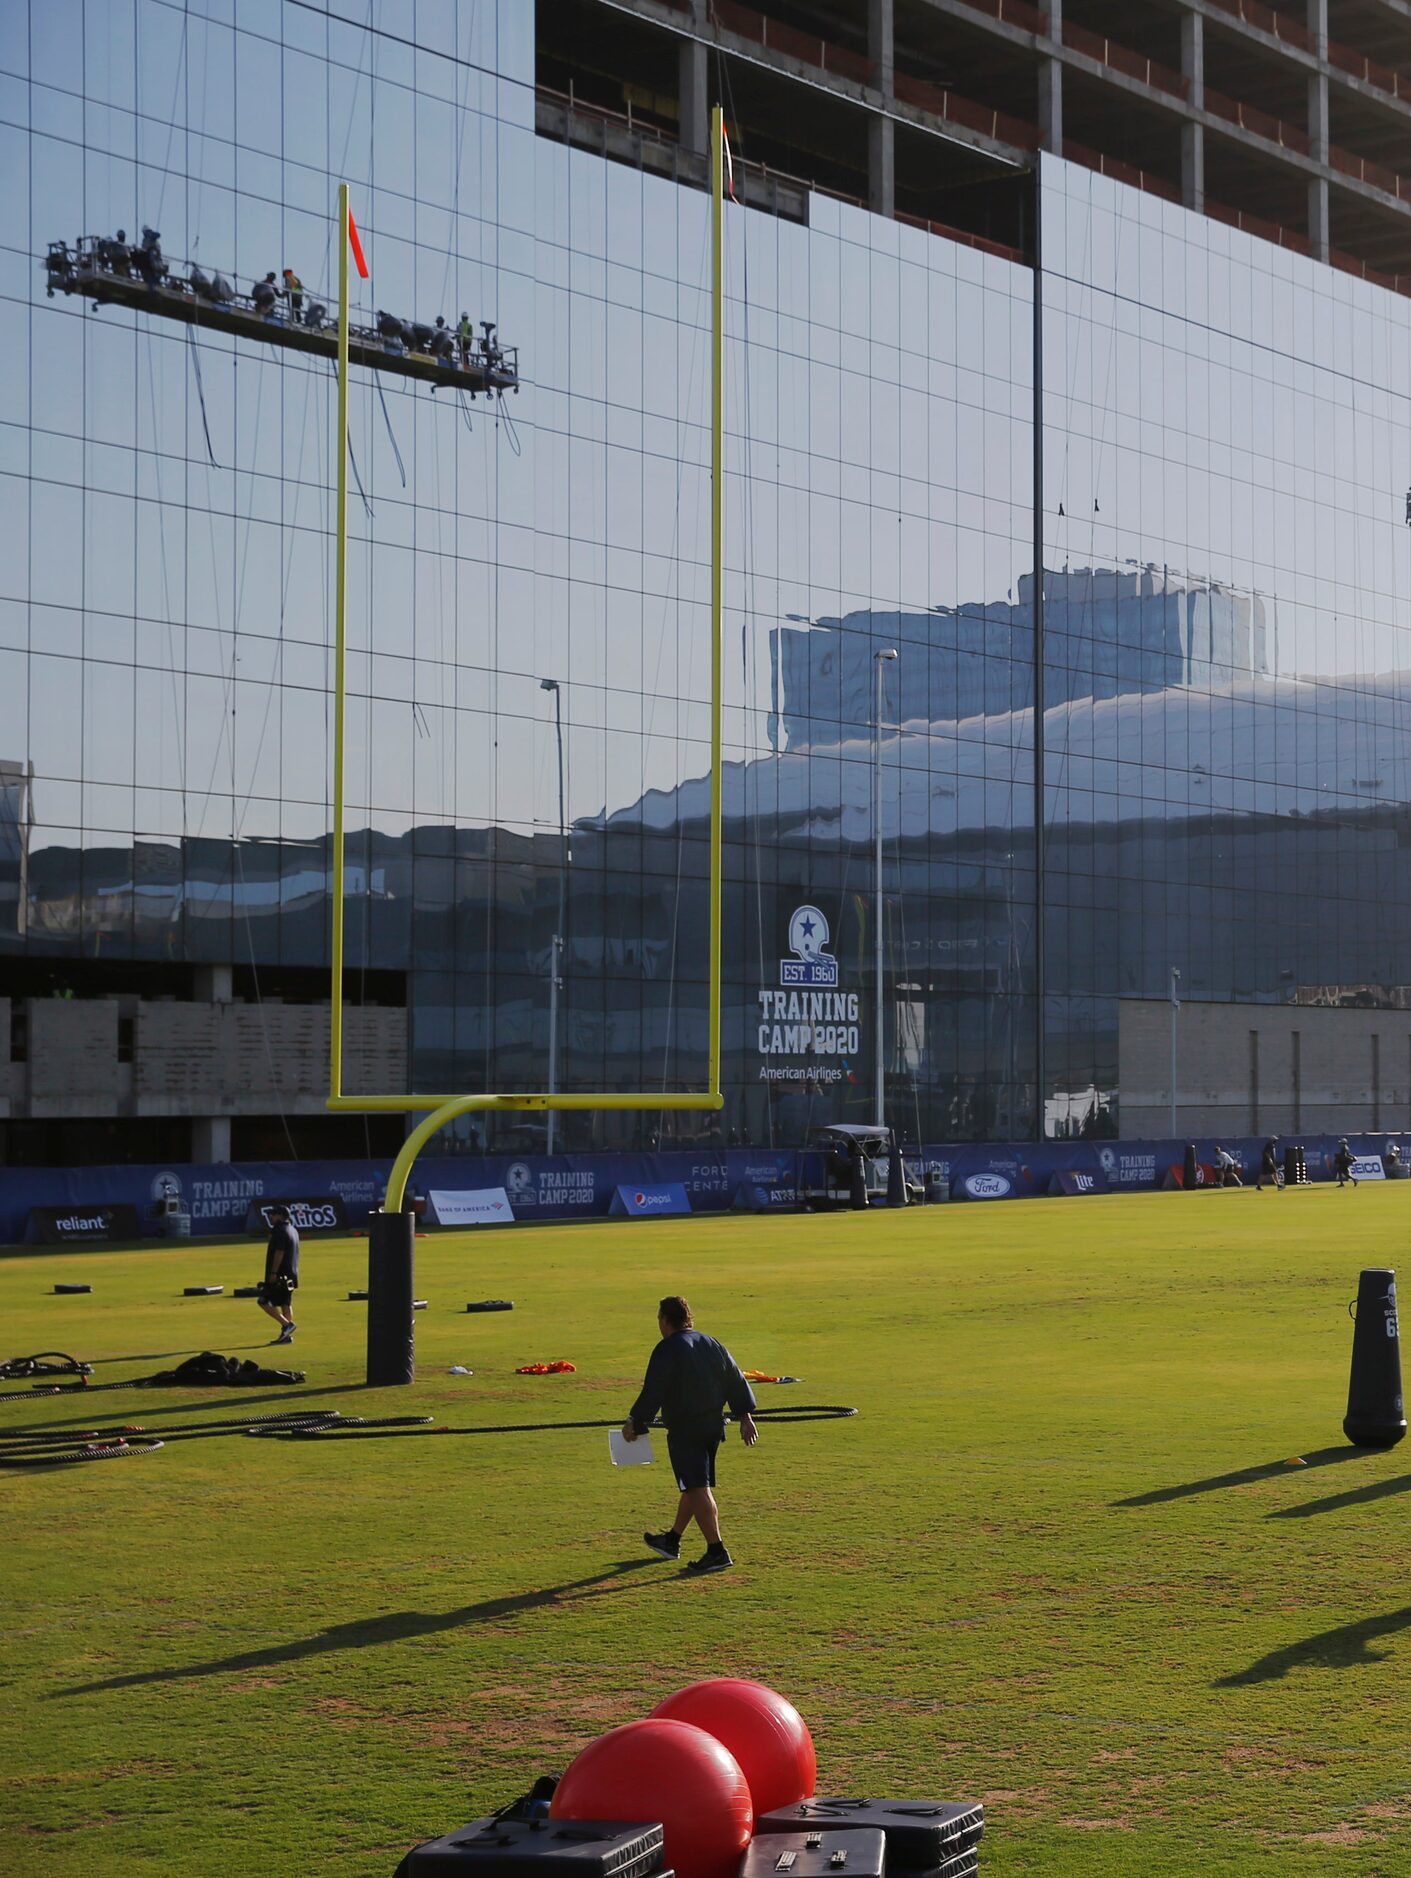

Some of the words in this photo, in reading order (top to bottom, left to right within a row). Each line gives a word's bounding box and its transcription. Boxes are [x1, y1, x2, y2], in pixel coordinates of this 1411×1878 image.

[783, 964, 808, 981] EST.
[811, 965, 835, 982] 1960
[758, 990, 859, 1022] TRAINING
[758, 1024, 812, 1054] CAMP
[815, 1025, 859, 1055] 2020
[759, 1065, 806, 1080] American
[807, 1066, 842, 1081] Airlines
[1119, 1154, 1156, 1169] TRAINING
[329, 1180, 375, 1192] American
[539, 1172, 595, 1188] TRAINING
[684, 1180, 728, 1192] CENTE
[975, 1177, 1001, 1193] Ford
[1074, 1174, 1094, 1191] Lite
[192, 1179, 264, 1200] TRAINING
[539, 1188, 568, 1205] CAMP
[568, 1188, 594, 1204] 2020
[647, 1189, 672, 1206] pepsi
[191, 1199, 231, 1218] CAMP
[232, 1199, 251, 1216] 20
[463, 1205, 490, 1213] AMERICA
[55, 1215, 106, 1231] reliant
